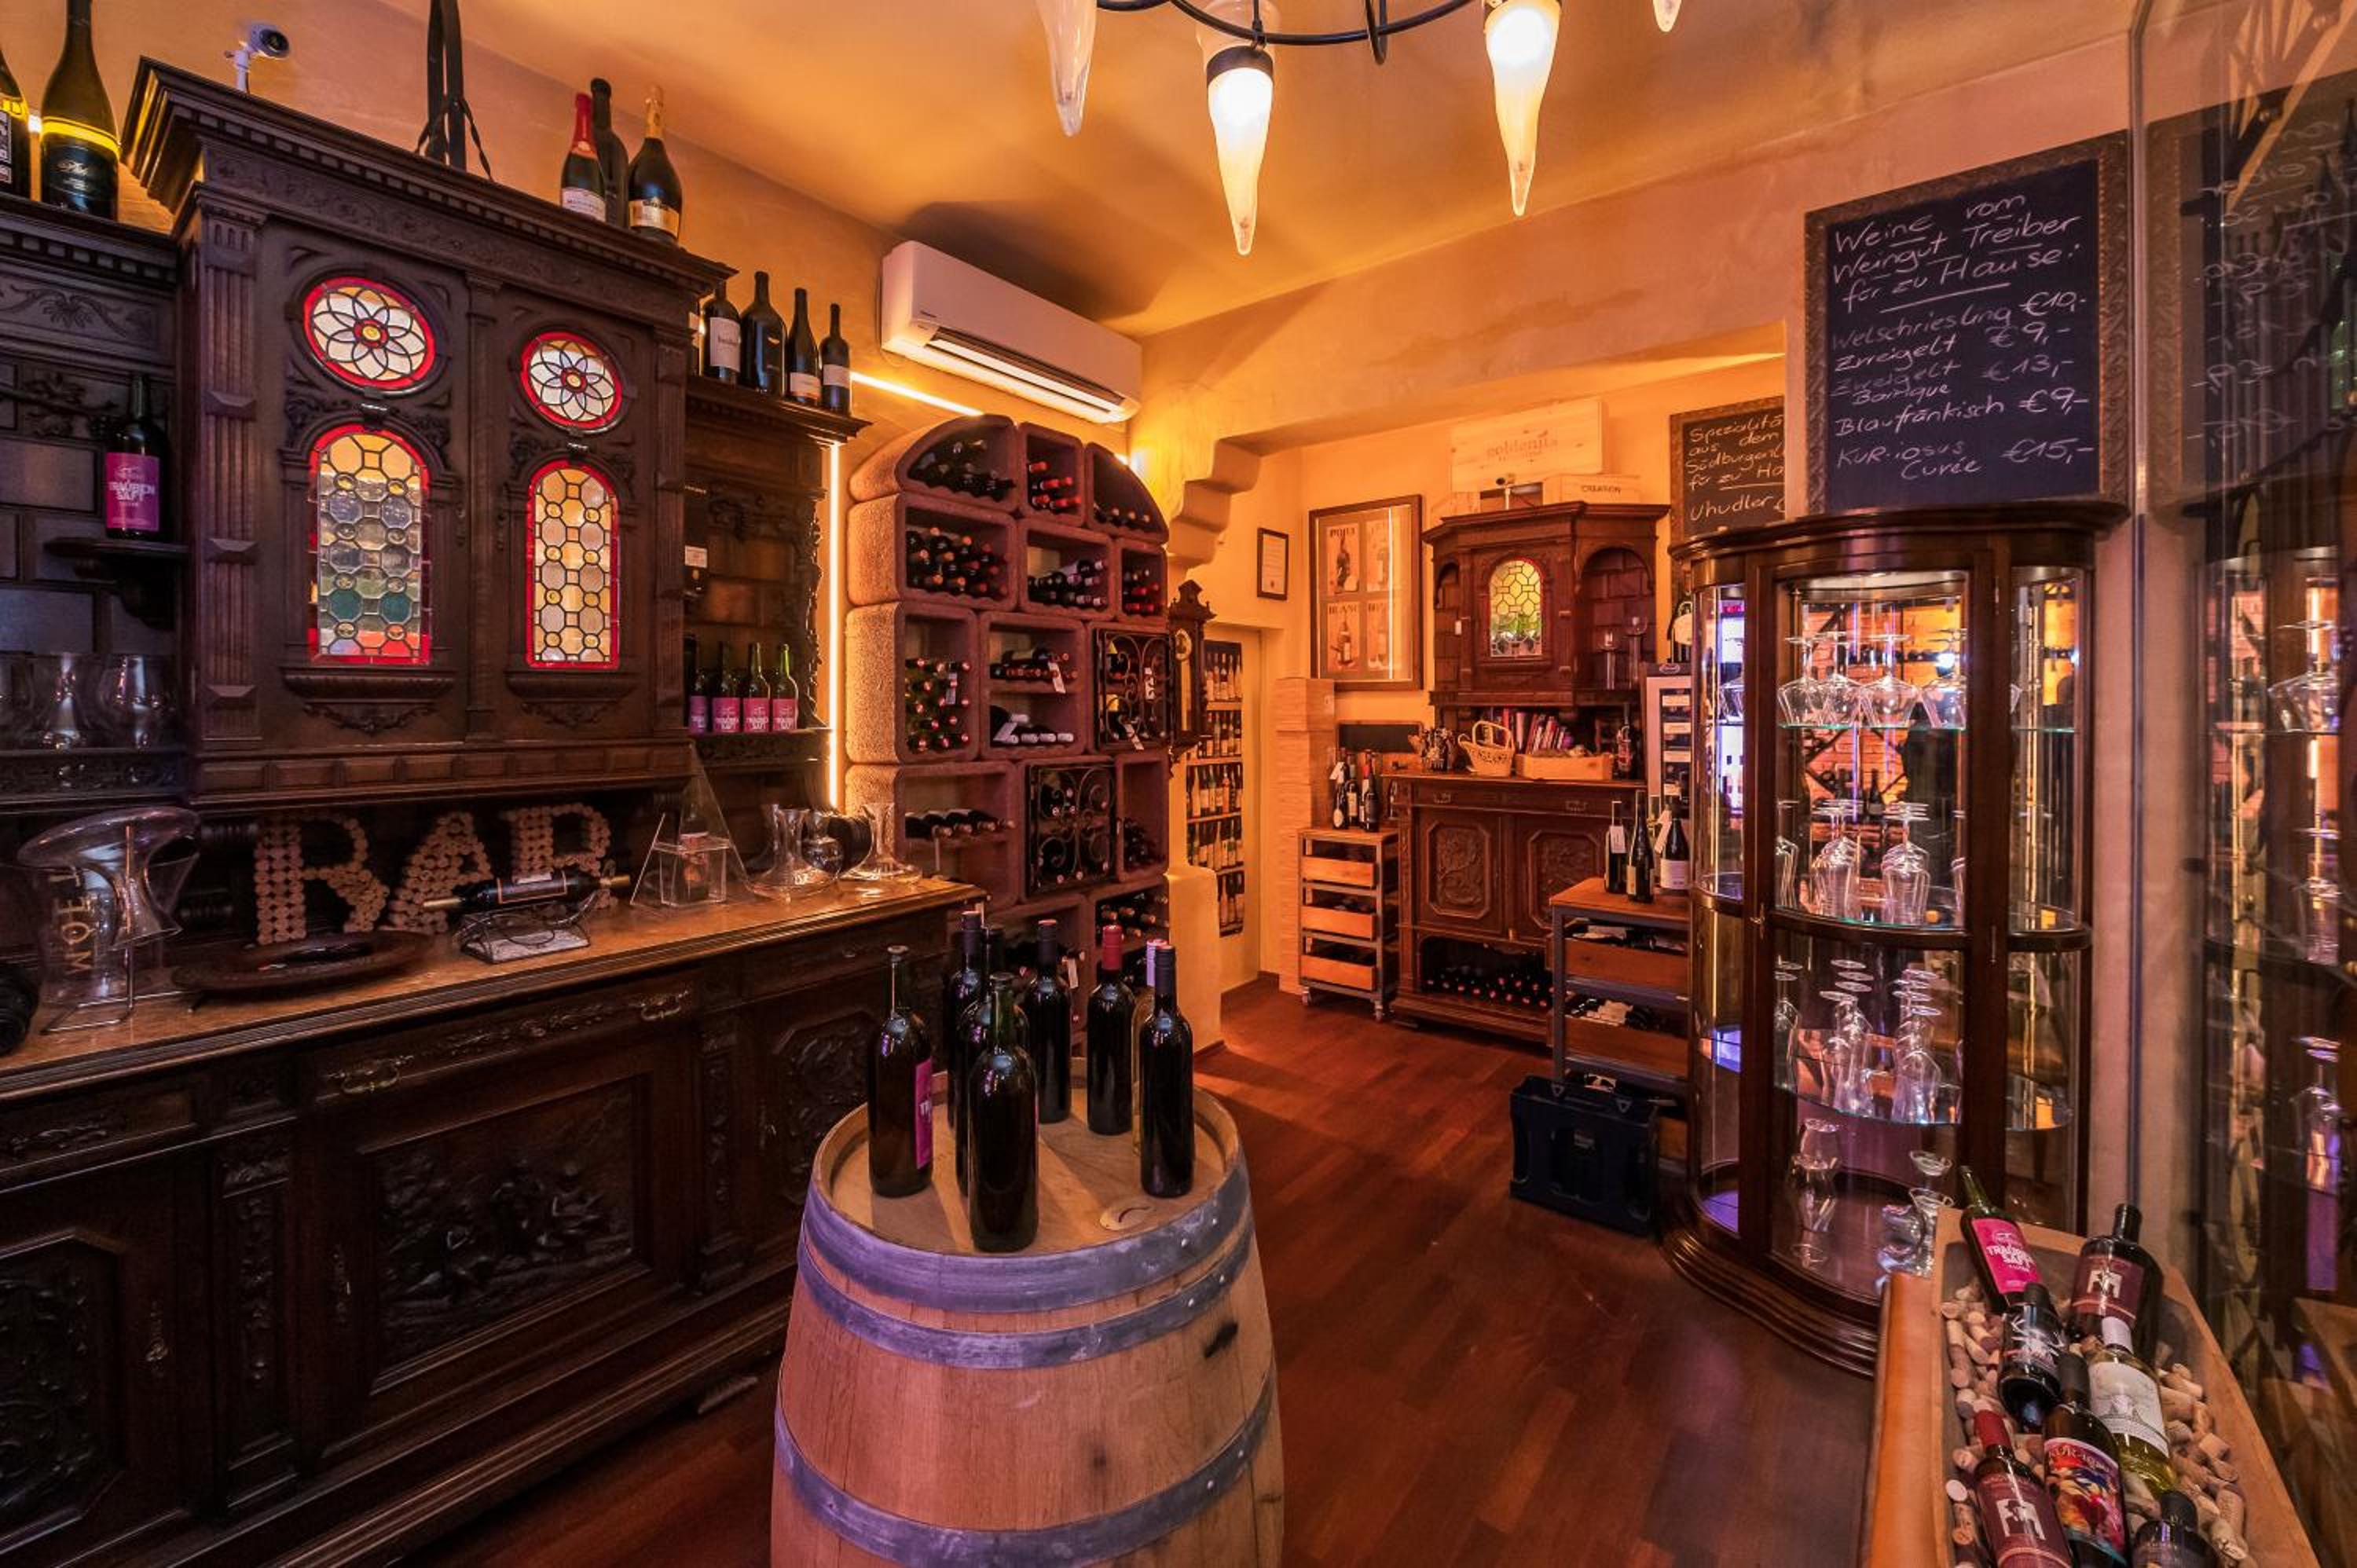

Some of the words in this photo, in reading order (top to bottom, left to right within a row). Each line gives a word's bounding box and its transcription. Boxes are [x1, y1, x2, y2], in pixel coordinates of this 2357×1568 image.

[1835, 214, 1934, 252] Weine
[1966, 195, 2025, 219] vom
[1834, 232, 1947, 284] Weingut
[1962, 212, 2080, 249] Treiber
[1892, 277, 1928, 294] zu
[1833, 304, 2011, 350] Welschriesling
[1835, 334, 1956, 372] Zweigelt
[1835, 394, 2004, 436] Blaufränkisch
[1689, 443, 1719, 456] aus
[1739, 432, 1779, 447] dem
[1901, 456, 1982, 480] Cuvée
[1690, 493, 1774, 521] Uhudler
